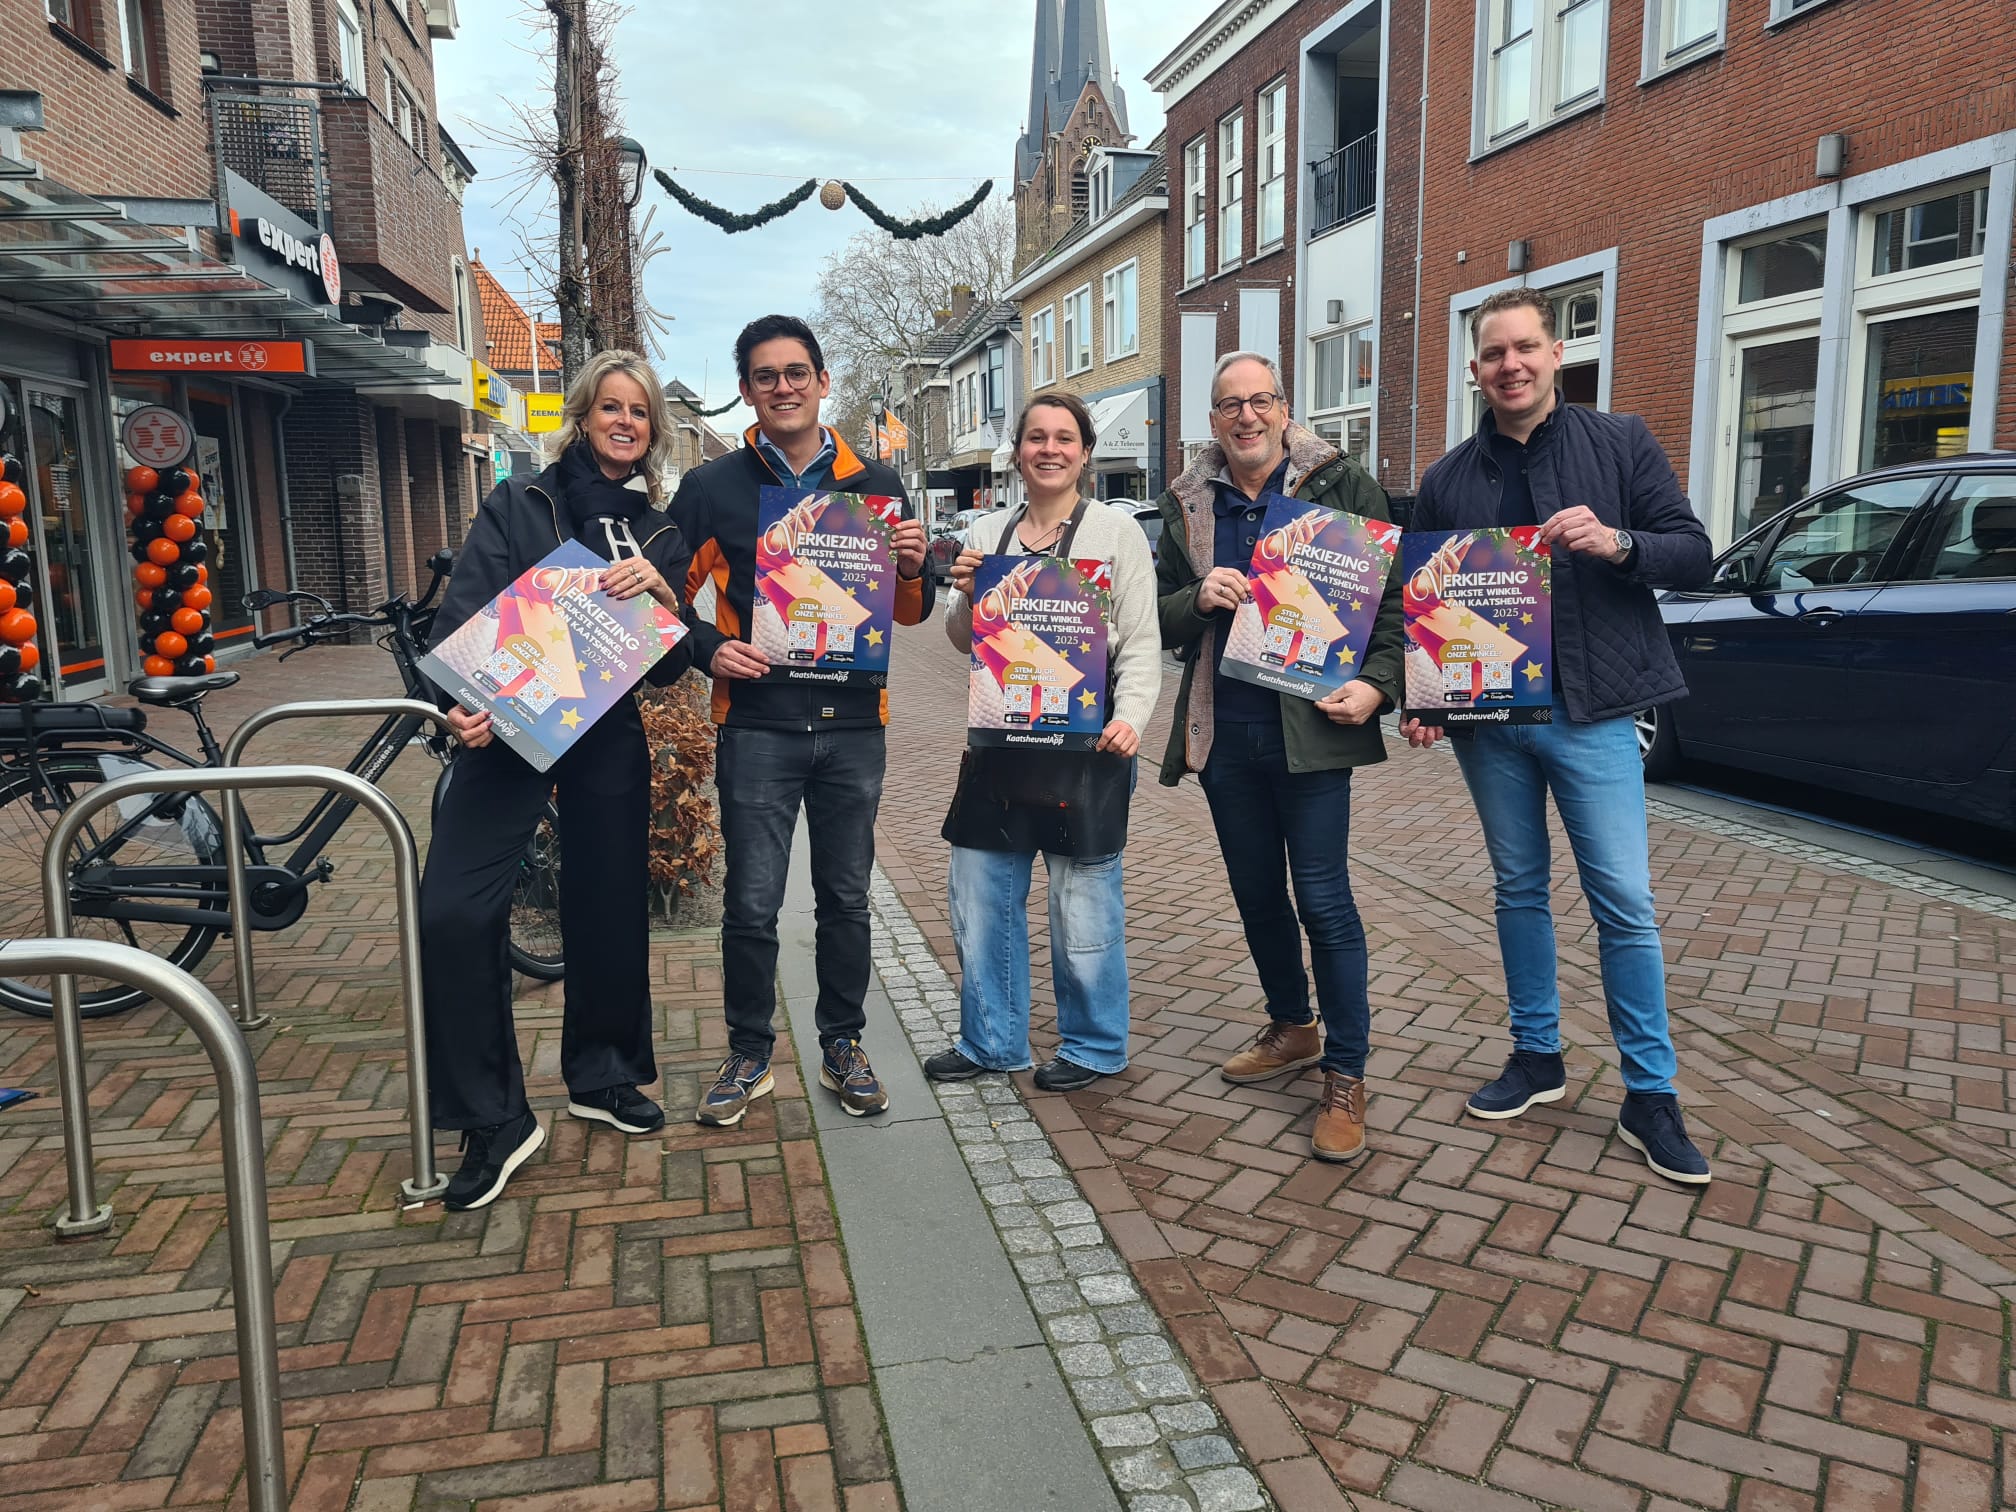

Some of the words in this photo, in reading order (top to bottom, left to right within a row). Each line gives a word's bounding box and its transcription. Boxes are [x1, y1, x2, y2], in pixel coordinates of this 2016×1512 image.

[258, 217, 320, 275] expert
[150, 350, 233, 365] expert
[764, 507, 878, 556] VERKIEZING
[1262, 521, 1370, 573] VERKIEZING
[797, 549, 834, 559] LEUKSTE
[838, 552, 870, 562] WINKEL
[797, 558, 816, 567] VAN
[819, 560, 884, 572] KAATSHEUVEL
[1290, 557, 1327, 572] LEUKSTE
[1329, 566, 1360, 582] WINKEL
[842, 572, 866, 582] 2025
[1289, 566, 1307, 577] VAN
[1309, 572, 1370, 595] KAATSHEUVEL
[1409, 550, 1528, 600] VERKIEZING
[979, 577, 1090, 622] VERKIEZING
[1328, 588, 1352, 601] 2025
[1444, 589, 1483, 598] LEUKSTE
[1486, 587, 1522, 596] WINKEL
[532, 566, 640, 651] VERKIEZING
[1444, 598, 1466, 608] VAN
[1468, 596, 1537, 607] KAATSHEUVEL
[1011, 614, 1048, 622] LEUKSTE
[1050, 615, 1083, 624] WINKEL
[1275, 615, 1294, 625] ONZE
[1281, 609, 1299, 618] STEM
[1492, 608, 1519, 618] 2025
[558, 597, 596, 635] LEUKSTE
[595, 629, 624, 656] WINKEL
[1011, 624, 1030, 632] VAN
[1033, 624, 1095, 634] KAATSHEUVEL
[553, 604, 572, 624] VAN
[571, 622, 628, 673] KAATSHEUVEL
[1055, 636, 1079, 645] 2025
[512, 643, 532, 660] ONZE
[521, 641, 541, 658] STEM
[582, 647, 607, 668] 2025
[789, 671, 848, 682] KaatsheuvelApp
[1257, 671, 1313, 694] KaatsheuvelApp
[1448, 710, 1509, 721] KaatsheuvelApp
[1006, 735, 1064, 746] KaatsheuvelApp
